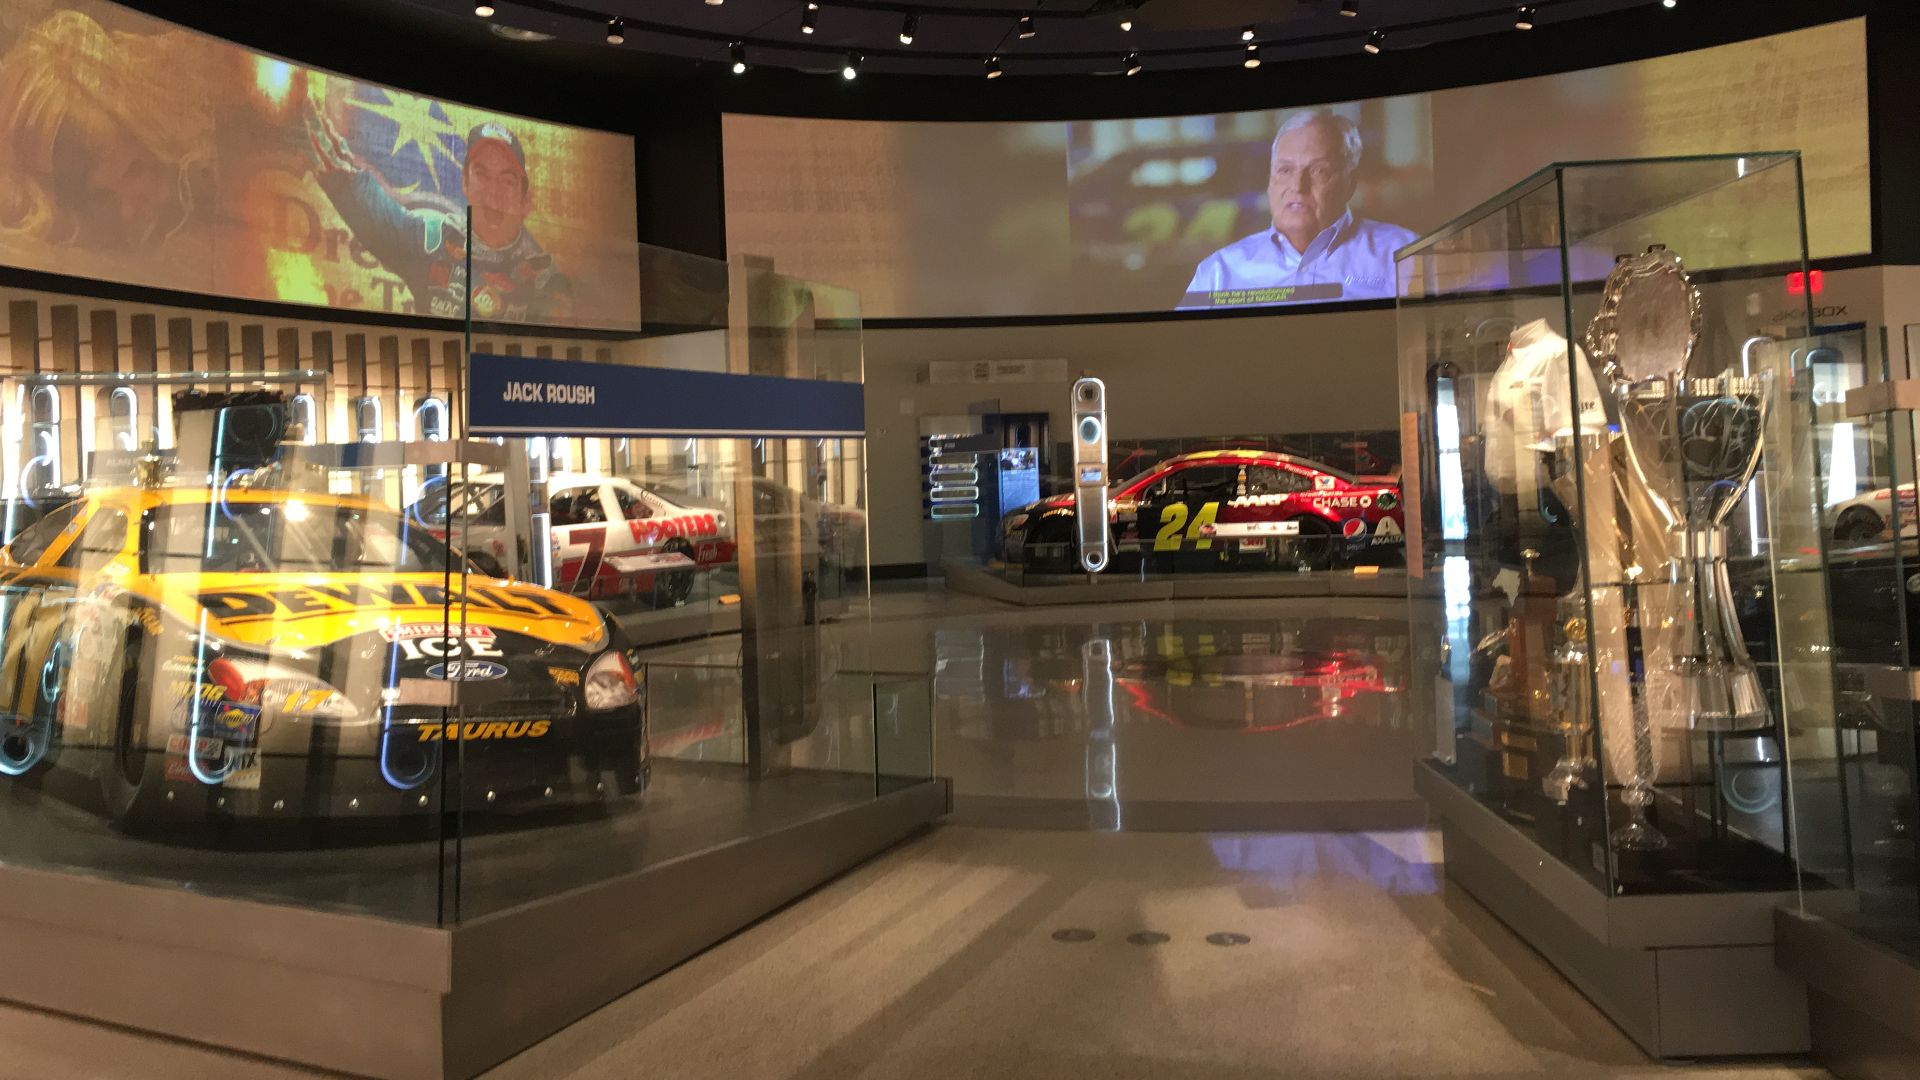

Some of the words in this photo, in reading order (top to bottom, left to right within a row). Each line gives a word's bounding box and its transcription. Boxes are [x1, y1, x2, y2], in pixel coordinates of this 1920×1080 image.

[503, 381, 543, 402] JACK
[547, 383, 595, 404] ROUSH
[1313, 497, 1358, 508] CHASE
[628, 514, 718, 545] HOOTERS
[1153, 501, 1219, 550] 24
[569, 527, 607, 594] 7
[198, 583, 572, 621] DEWALT
[400, 636, 504, 660] ICE
[282, 689, 334, 714] 17
[417, 719, 551, 742] TAURUS
